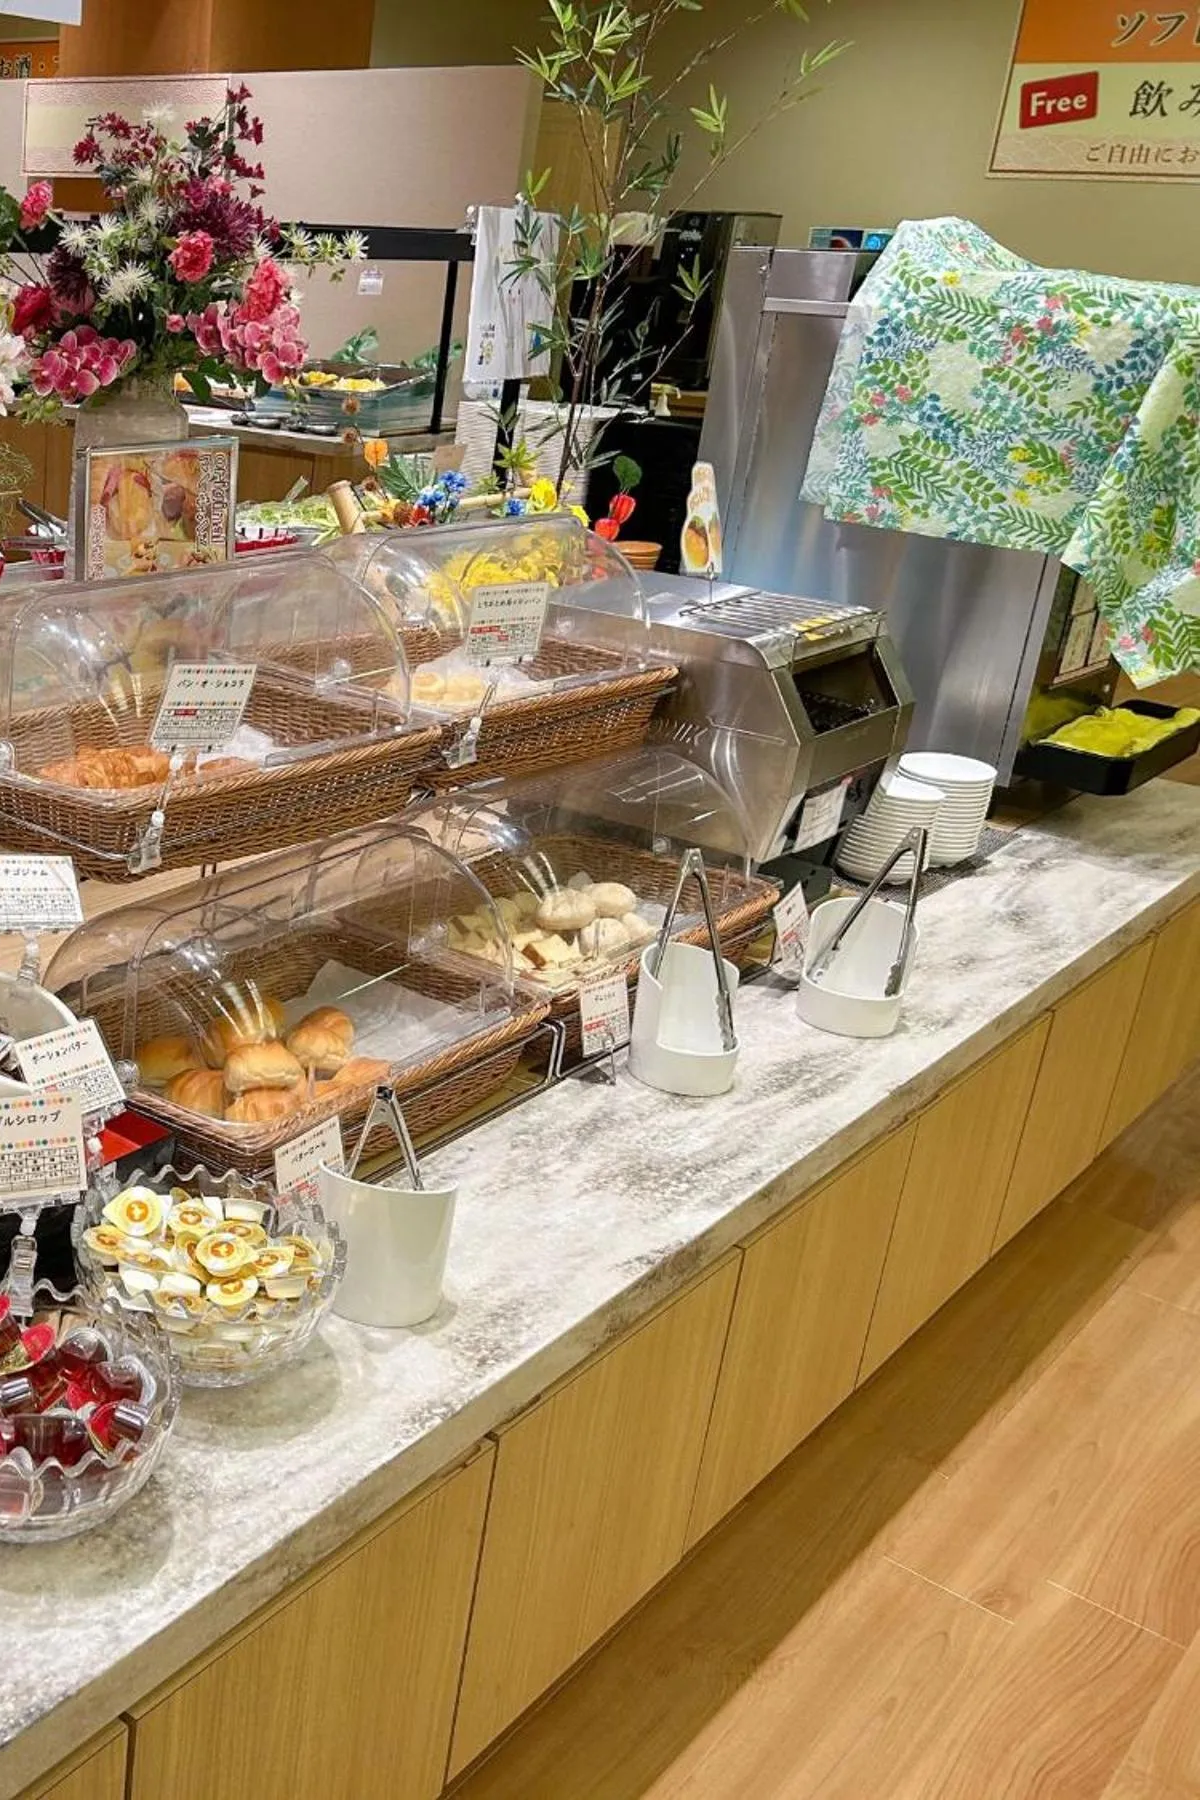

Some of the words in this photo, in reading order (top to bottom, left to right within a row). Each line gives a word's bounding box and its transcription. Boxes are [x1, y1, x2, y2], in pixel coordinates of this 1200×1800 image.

[1030, 91, 1088, 117] Free
[1086, 143, 1199, 164] ご自由にお
